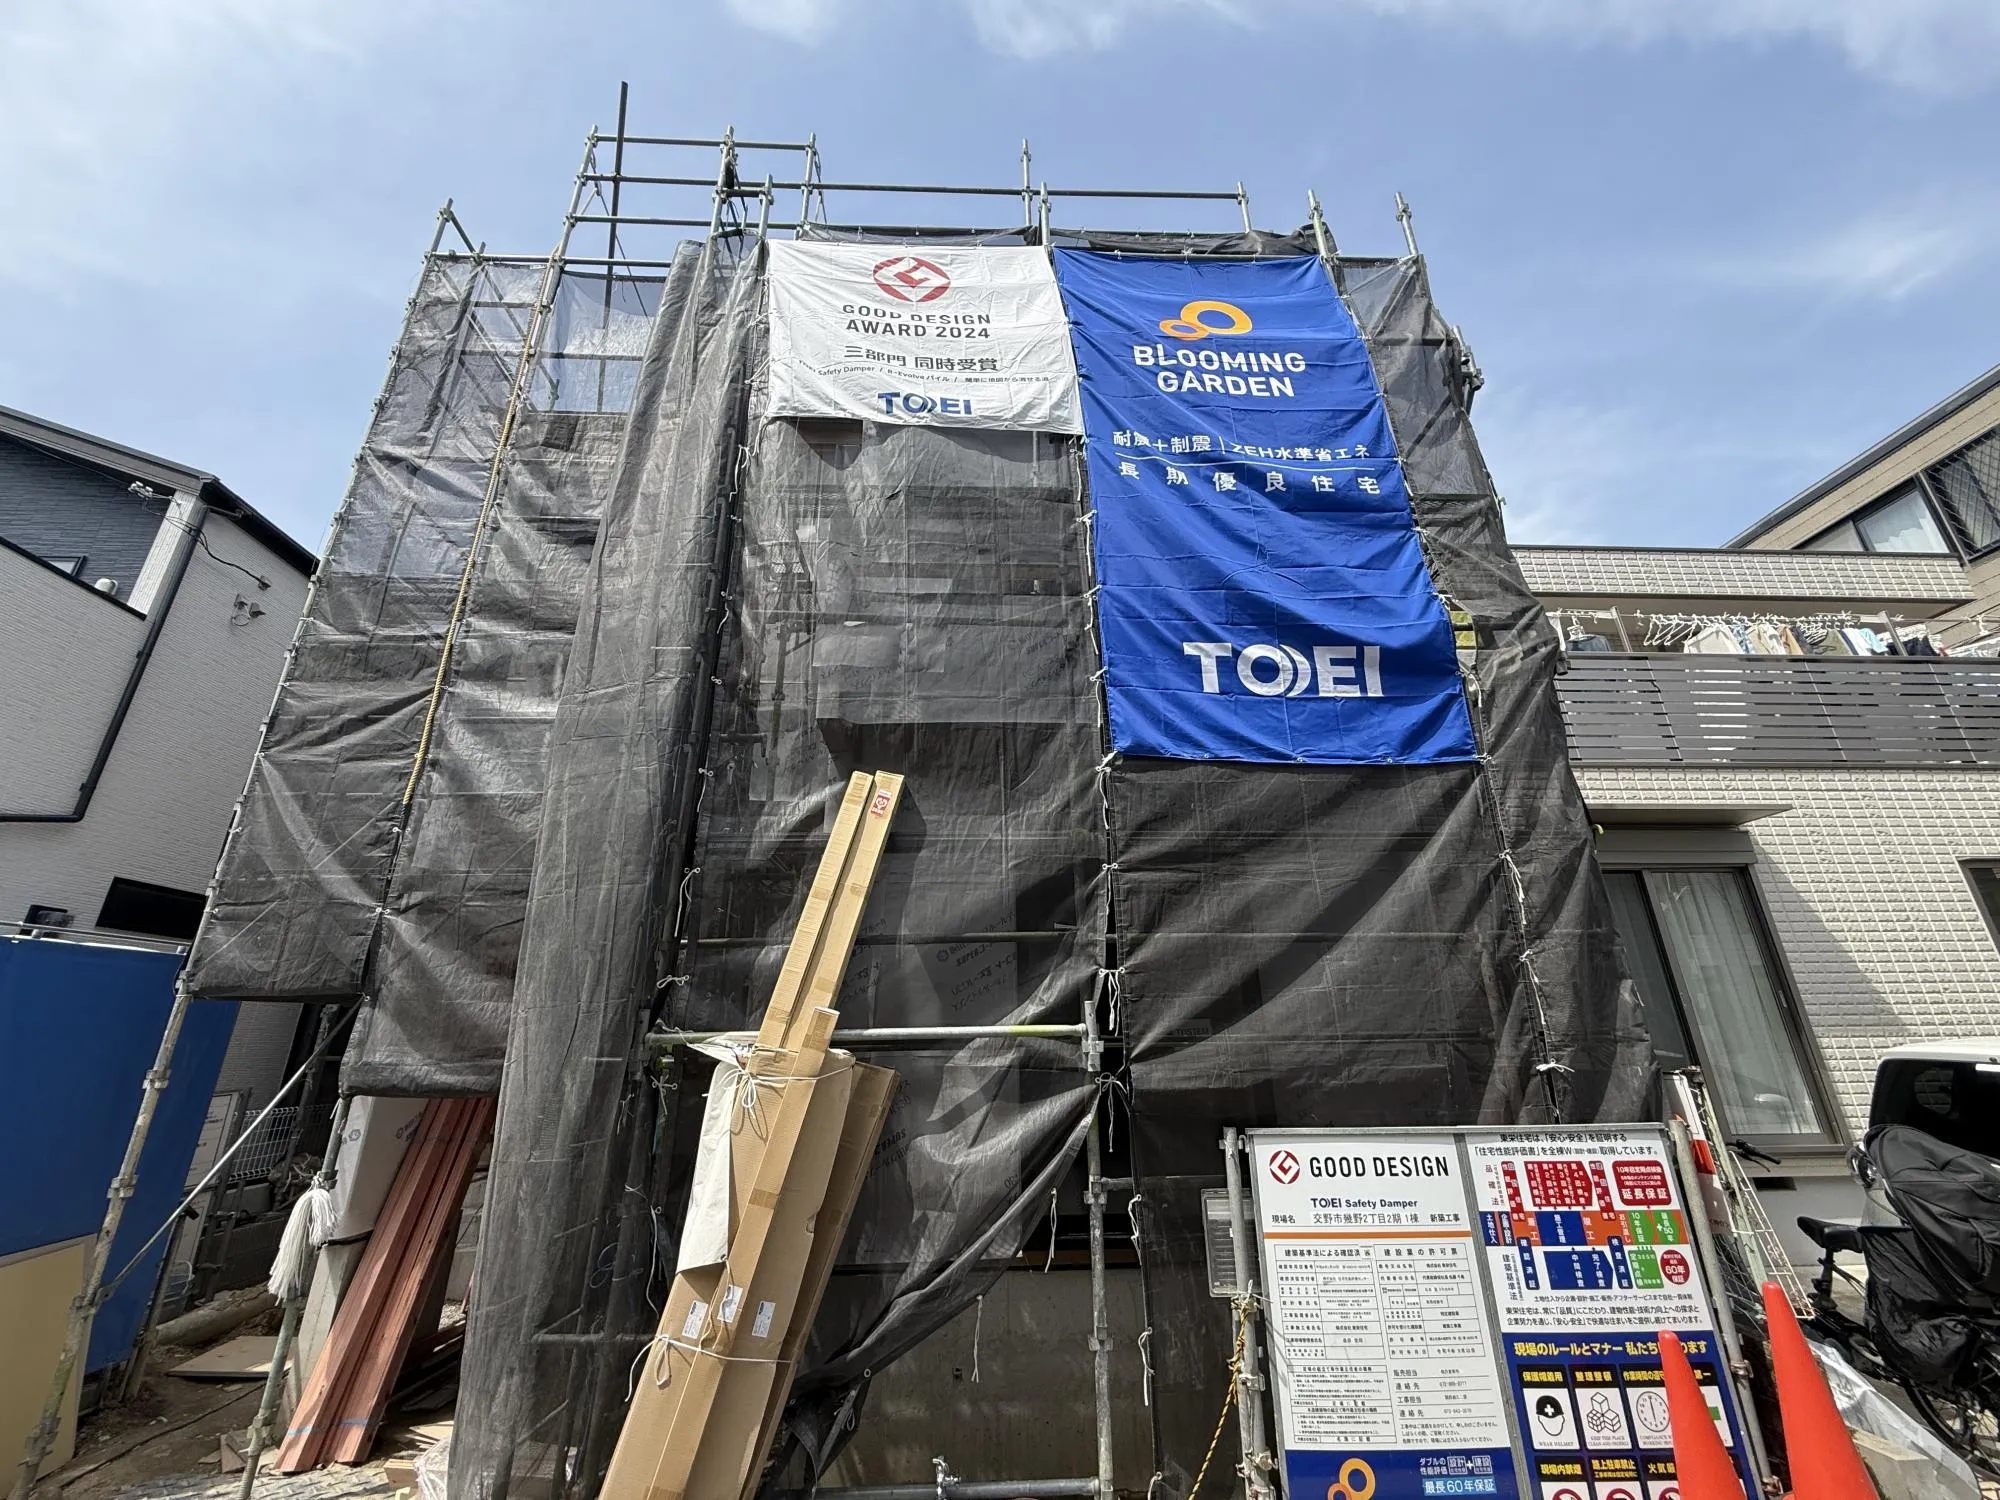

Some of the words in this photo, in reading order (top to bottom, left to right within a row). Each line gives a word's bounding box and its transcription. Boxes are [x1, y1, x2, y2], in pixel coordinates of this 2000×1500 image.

[842, 304, 902, 319] GOOD
[910, 312, 991, 324] DESIGN
[846, 319, 927, 337] AWARD
[935, 325, 990, 339] 2024
[844, 345, 907, 367] 三部門
[914, 356, 999, 371] 同時受賞
[1132, 344, 1306, 373] BLOOMING
[843, 366, 875, 375] Damper
[1156, 371, 1295, 398] GARDEN
[1231, 443, 1370, 461] ZEH水準省エネ
[1118, 460, 1381, 495] 長期優良住宅
[1309, 1156, 1366, 1178] GOOD
[1372, 1156, 1450, 1177] DESIGN
[1621, 1188, 1669, 1200] 延長保証
[1345, 1199, 1377, 1210] Safety
[1380, 1199, 1418, 1209] Damper
[1271, 1214, 1297, 1224] 現場名
[1430, 1213, 1461, 1223] 新築工事
[1631, 1212, 1645, 1243] 10年保証
[1486, 1213, 1498, 1244] 土地仕入
[1591, 1254, 1606, 1288] 完了検査
[1665, 1265, 1686, 1274] 60年
[1513, 1342, 1623, 1356] 現場のルールとマナー
[1420, 1457, 1447, 1466] ダブルの
[1424, 1478, 1497, 1494] 最長60年保証
